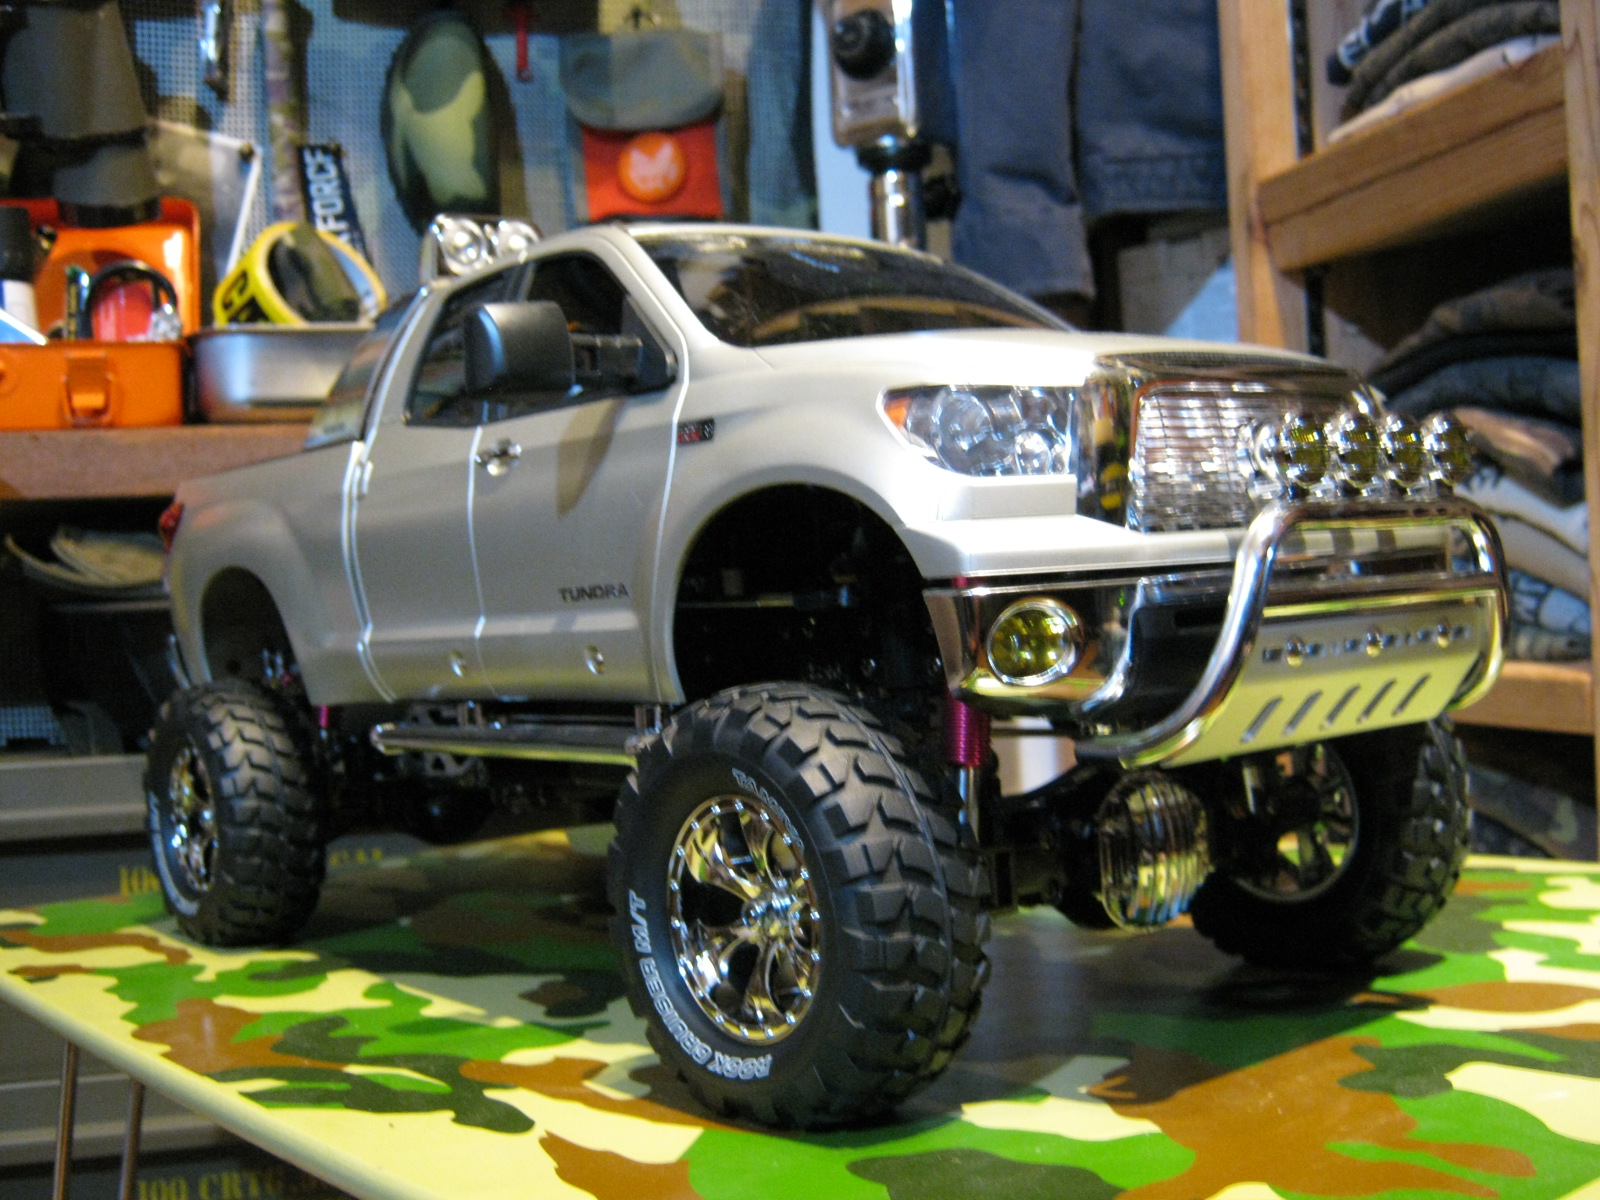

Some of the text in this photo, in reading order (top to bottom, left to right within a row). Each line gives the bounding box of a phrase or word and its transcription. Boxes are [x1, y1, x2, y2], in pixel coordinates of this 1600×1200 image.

[557, 582, 630, 603] TUNDRA
[628, 888, 773, 1081] ROCK CRUISER M/T
